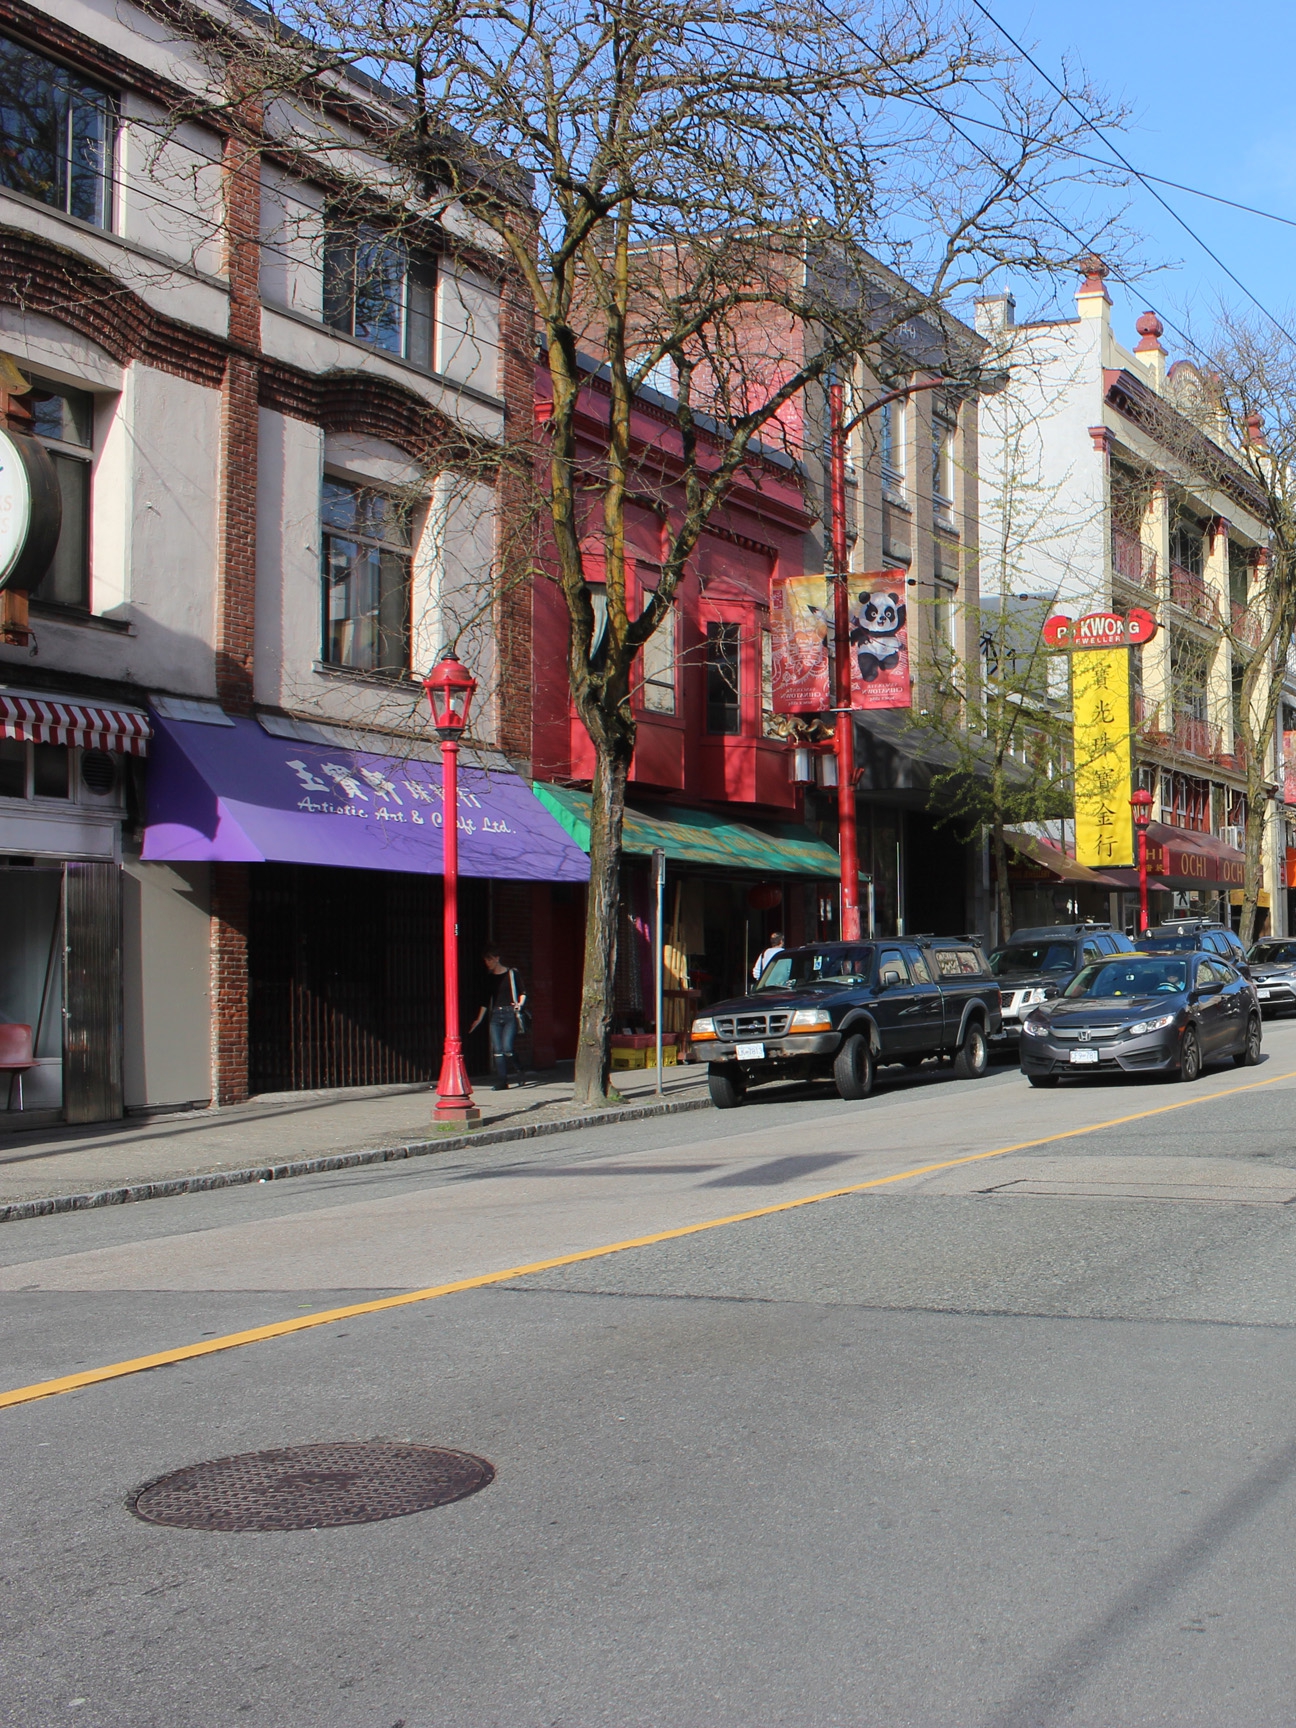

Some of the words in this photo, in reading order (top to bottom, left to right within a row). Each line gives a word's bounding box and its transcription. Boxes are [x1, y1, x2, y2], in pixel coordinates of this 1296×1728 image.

[1070, 635, 1122, 645] EWELLER
[297, 796, 369, 818] Artistic
[431, 811, 477, 835] Caft
[482, 816, 518, 835] Ltd.
[1181, 853, 1207, 877] OCHI
